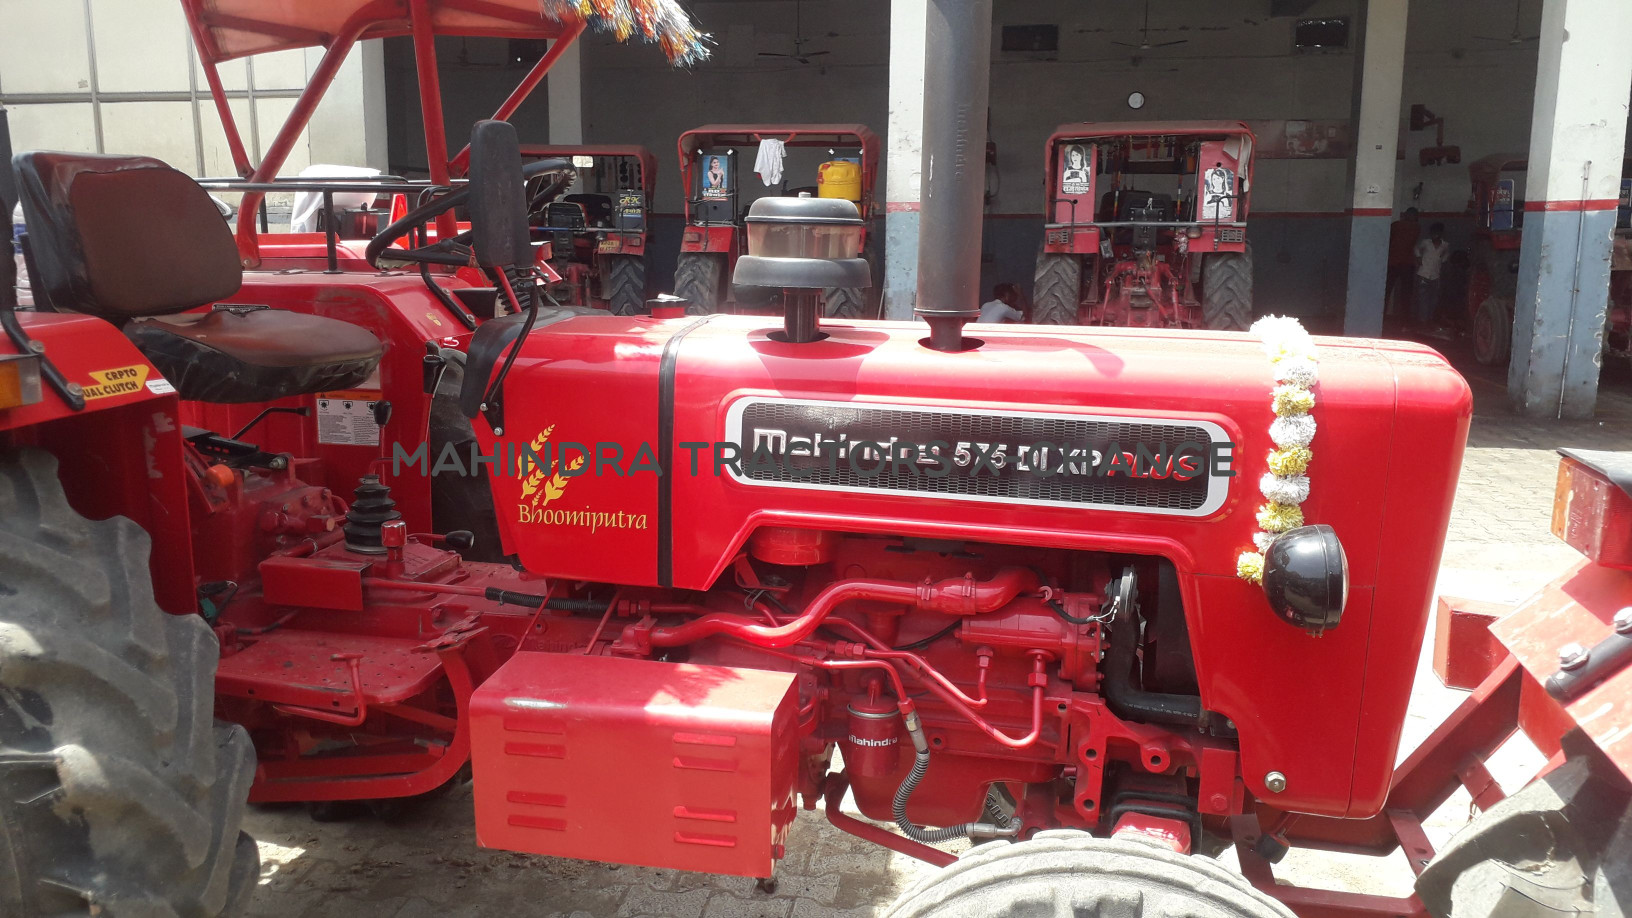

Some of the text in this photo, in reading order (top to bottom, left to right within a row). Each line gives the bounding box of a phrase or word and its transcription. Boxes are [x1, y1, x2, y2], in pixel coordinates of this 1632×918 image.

[105, 368, 138, 382] CRPTO
[82, 386, 104, 399] UAL
[103, 381, 139, 395] CLUTCH
[517, 502, 647, 534] Bhoomiputra
[849, 734, 898, 747] Mahindra
